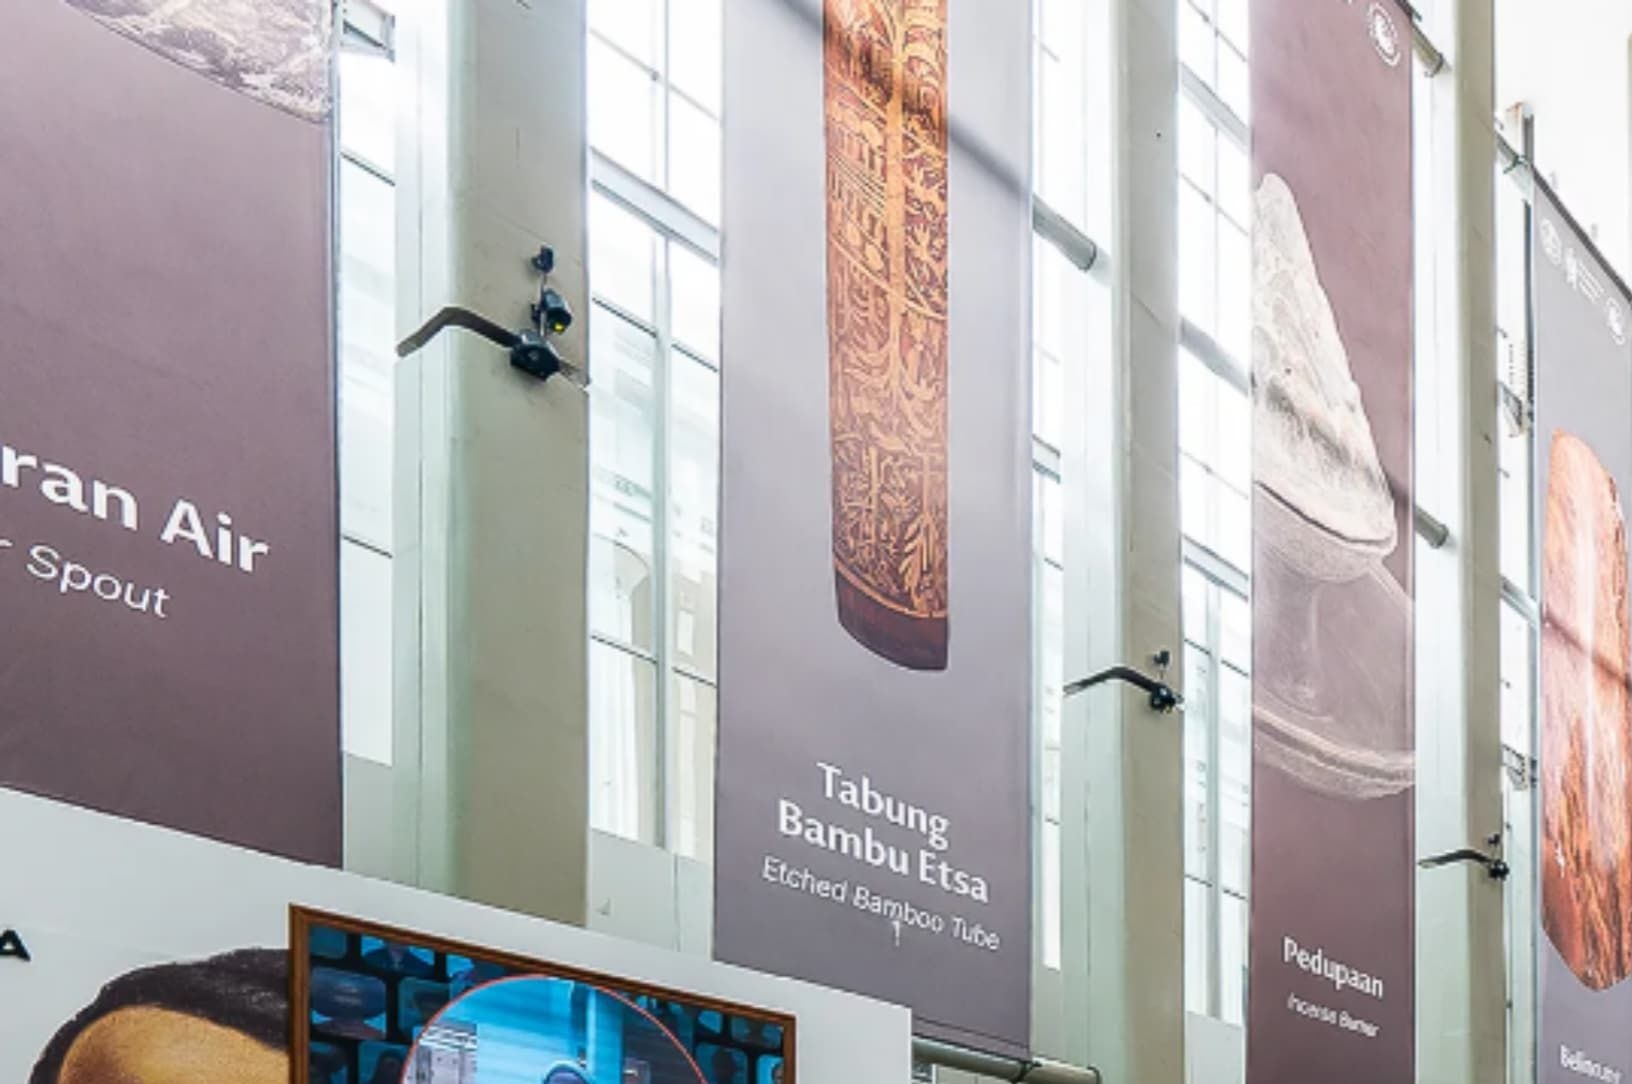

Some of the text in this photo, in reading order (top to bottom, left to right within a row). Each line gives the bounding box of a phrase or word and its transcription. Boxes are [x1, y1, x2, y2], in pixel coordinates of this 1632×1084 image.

[1, 446, 270, 573] ran Air
[26, 544, 170, 618] Spout
[779, 798, 989, 903] Bambu Etsa
[817, 761, 950, 850] Tabung
[762, 855, 1000, 950] Etched Bamboo Tube
[1283, 935, 1384, 999] Pedupaan
